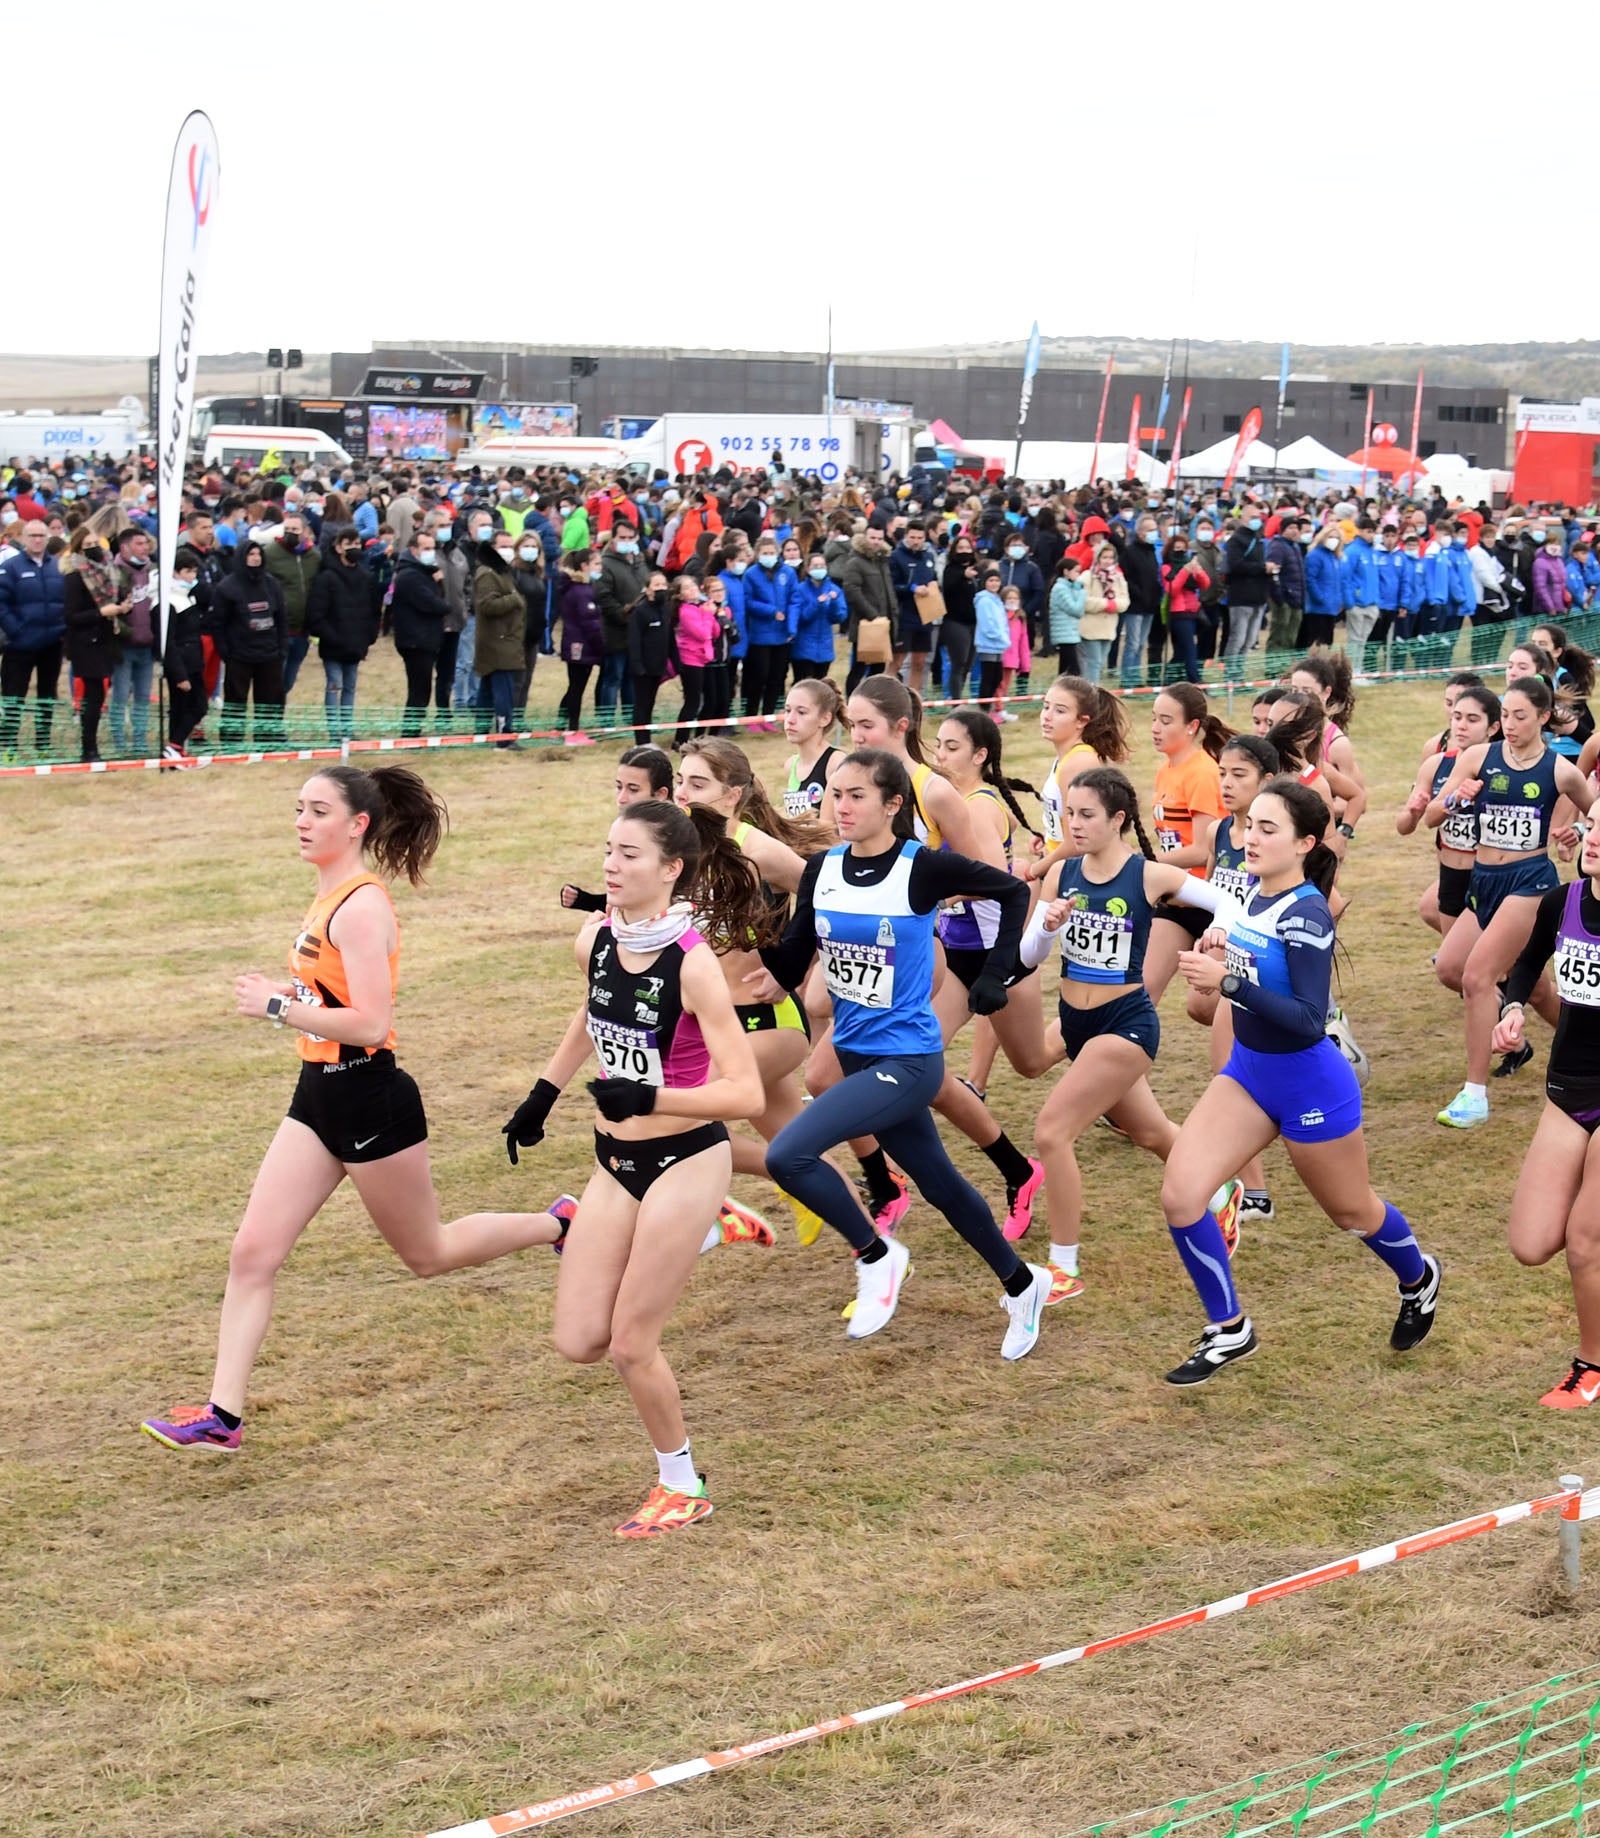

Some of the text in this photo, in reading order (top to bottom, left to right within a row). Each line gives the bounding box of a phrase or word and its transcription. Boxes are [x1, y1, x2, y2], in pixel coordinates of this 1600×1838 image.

[44, 427, 83, 446] pixel
[720, 437, 840, 451] 902 55 78 98
[1487, 816, 1532, 838] 4513
[821, 938, 887, 957] DIPUTACIÓN
[1065, 925, 1119, 954] 4511
[822, 945, 887, 965] BURGOS
[827, 956, 883, 989] 4577
[322, 1062, 347, 1075] NIKE
[740, 1725, 819, 1755] DIPUTACIÓN
[528, 1785, 615, 1819] DIPUTACIÓN
